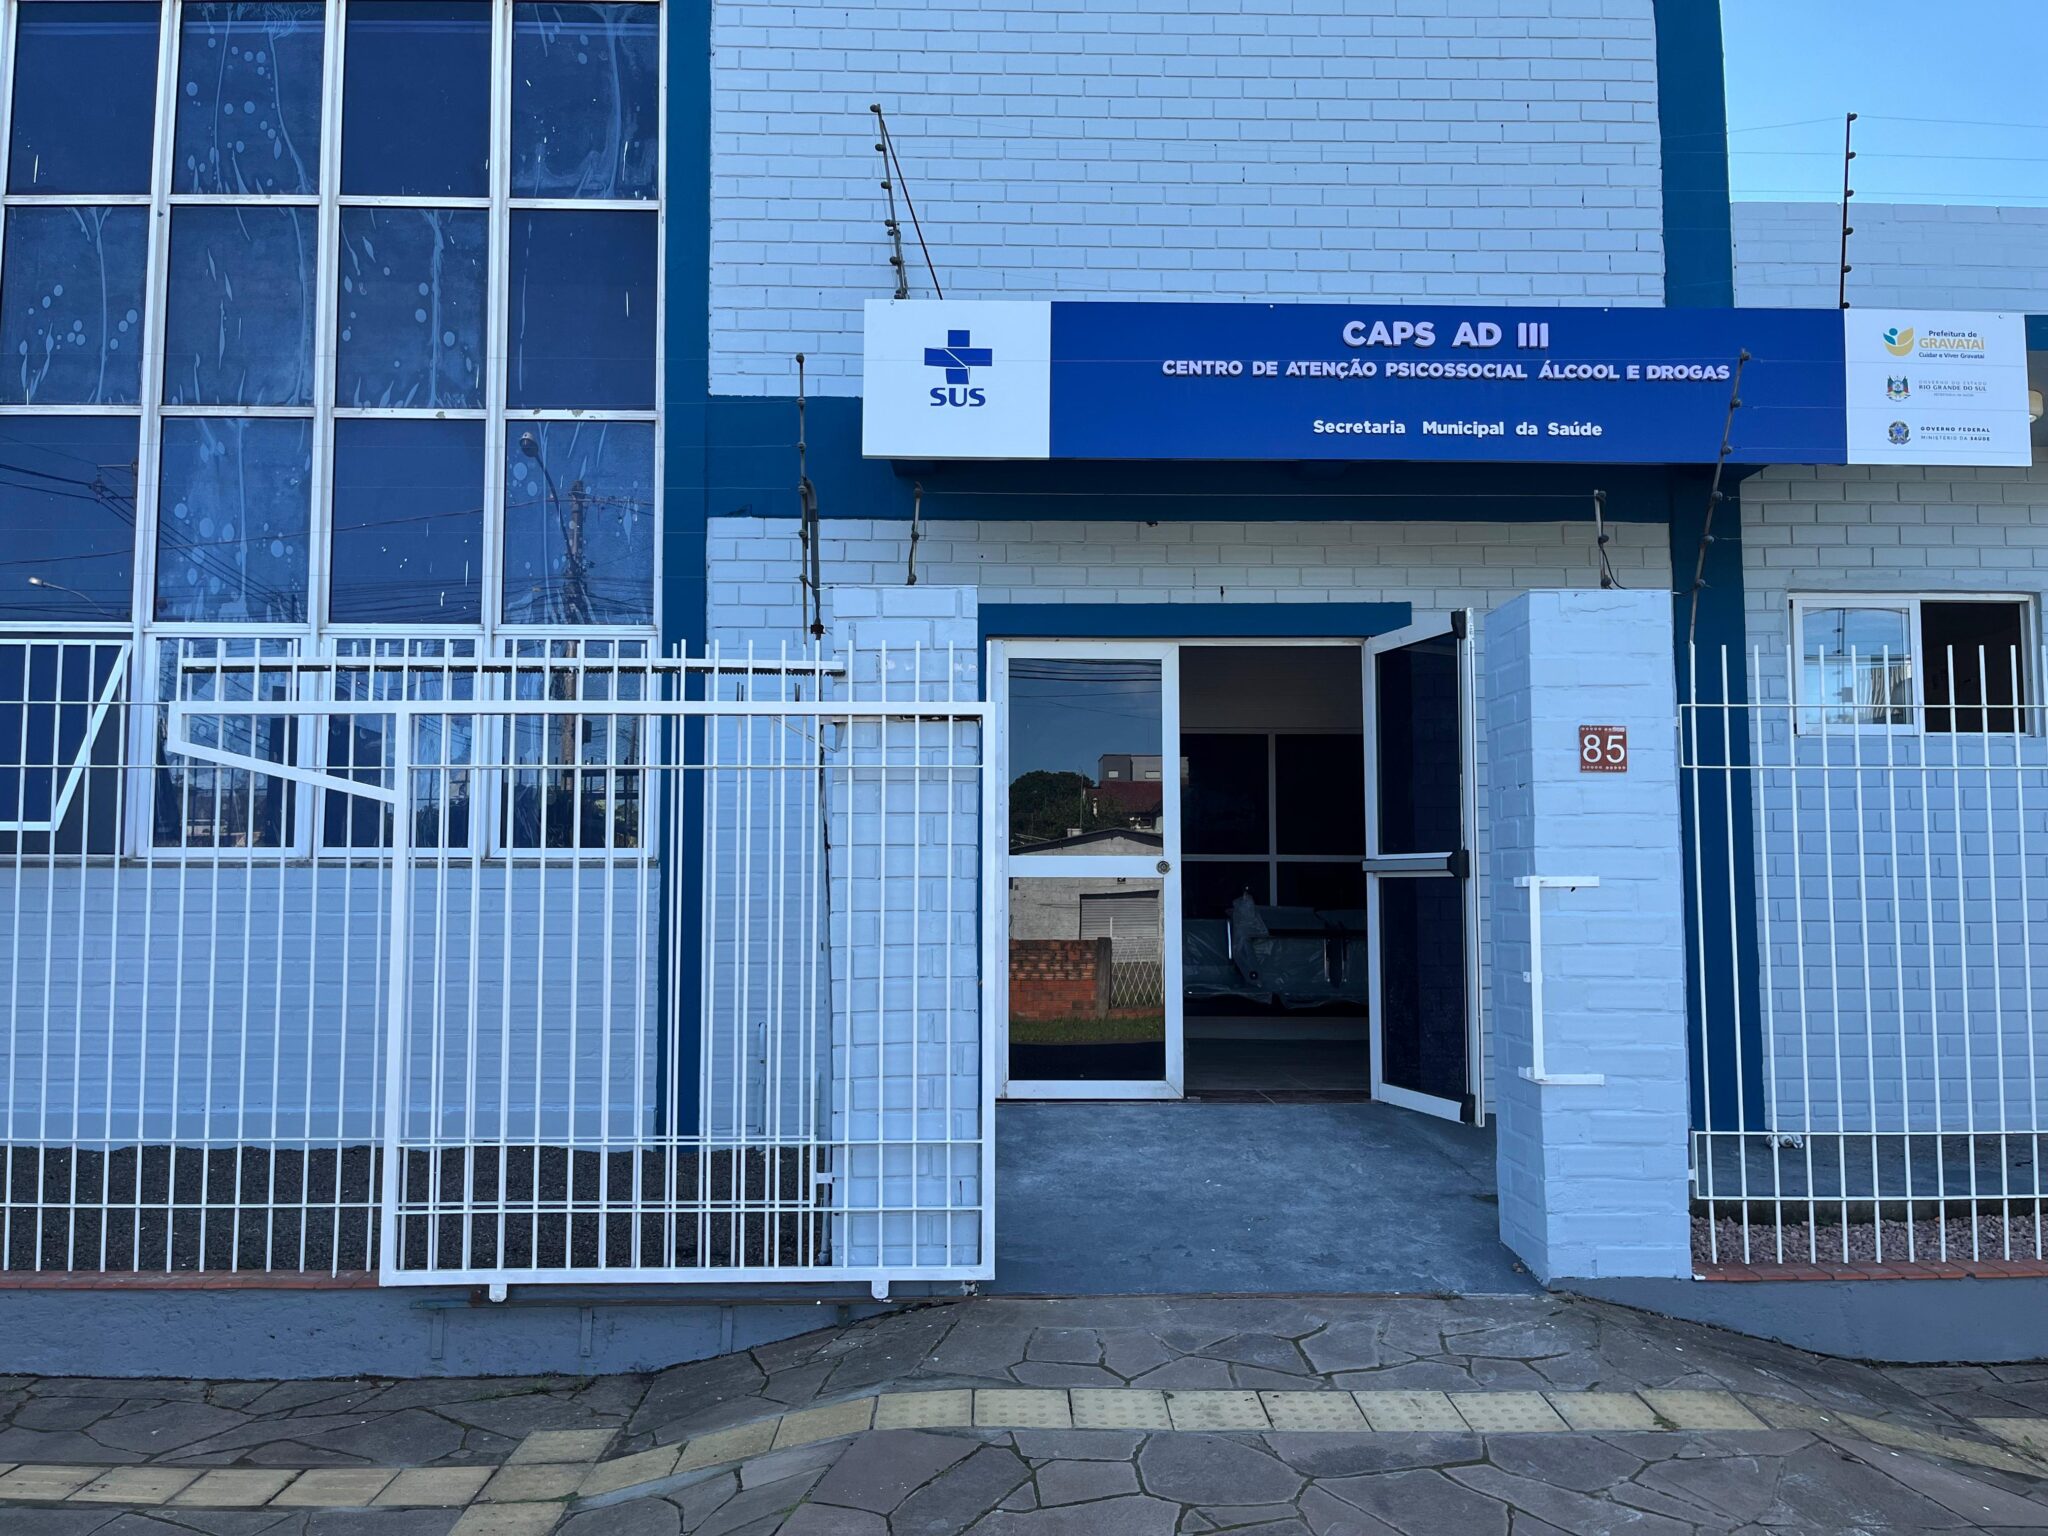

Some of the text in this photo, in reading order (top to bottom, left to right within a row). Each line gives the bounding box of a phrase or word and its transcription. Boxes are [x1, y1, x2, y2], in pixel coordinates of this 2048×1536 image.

[1342, 320, 1549, 349] CAPS AD III
[1919, 337, 1985, 350] GRAVATAÍ
[1162, 359, 1730, 381] CENTRO DE ATENÇÃO PSICOSSOCIAL ÁLCOOL E DROGAS
[929, 387, 987, 408] SUS
[1313, 419, 1603, 438] Secretaria Municipal da Saúde
[1582, 734, 1625, 763] 85
